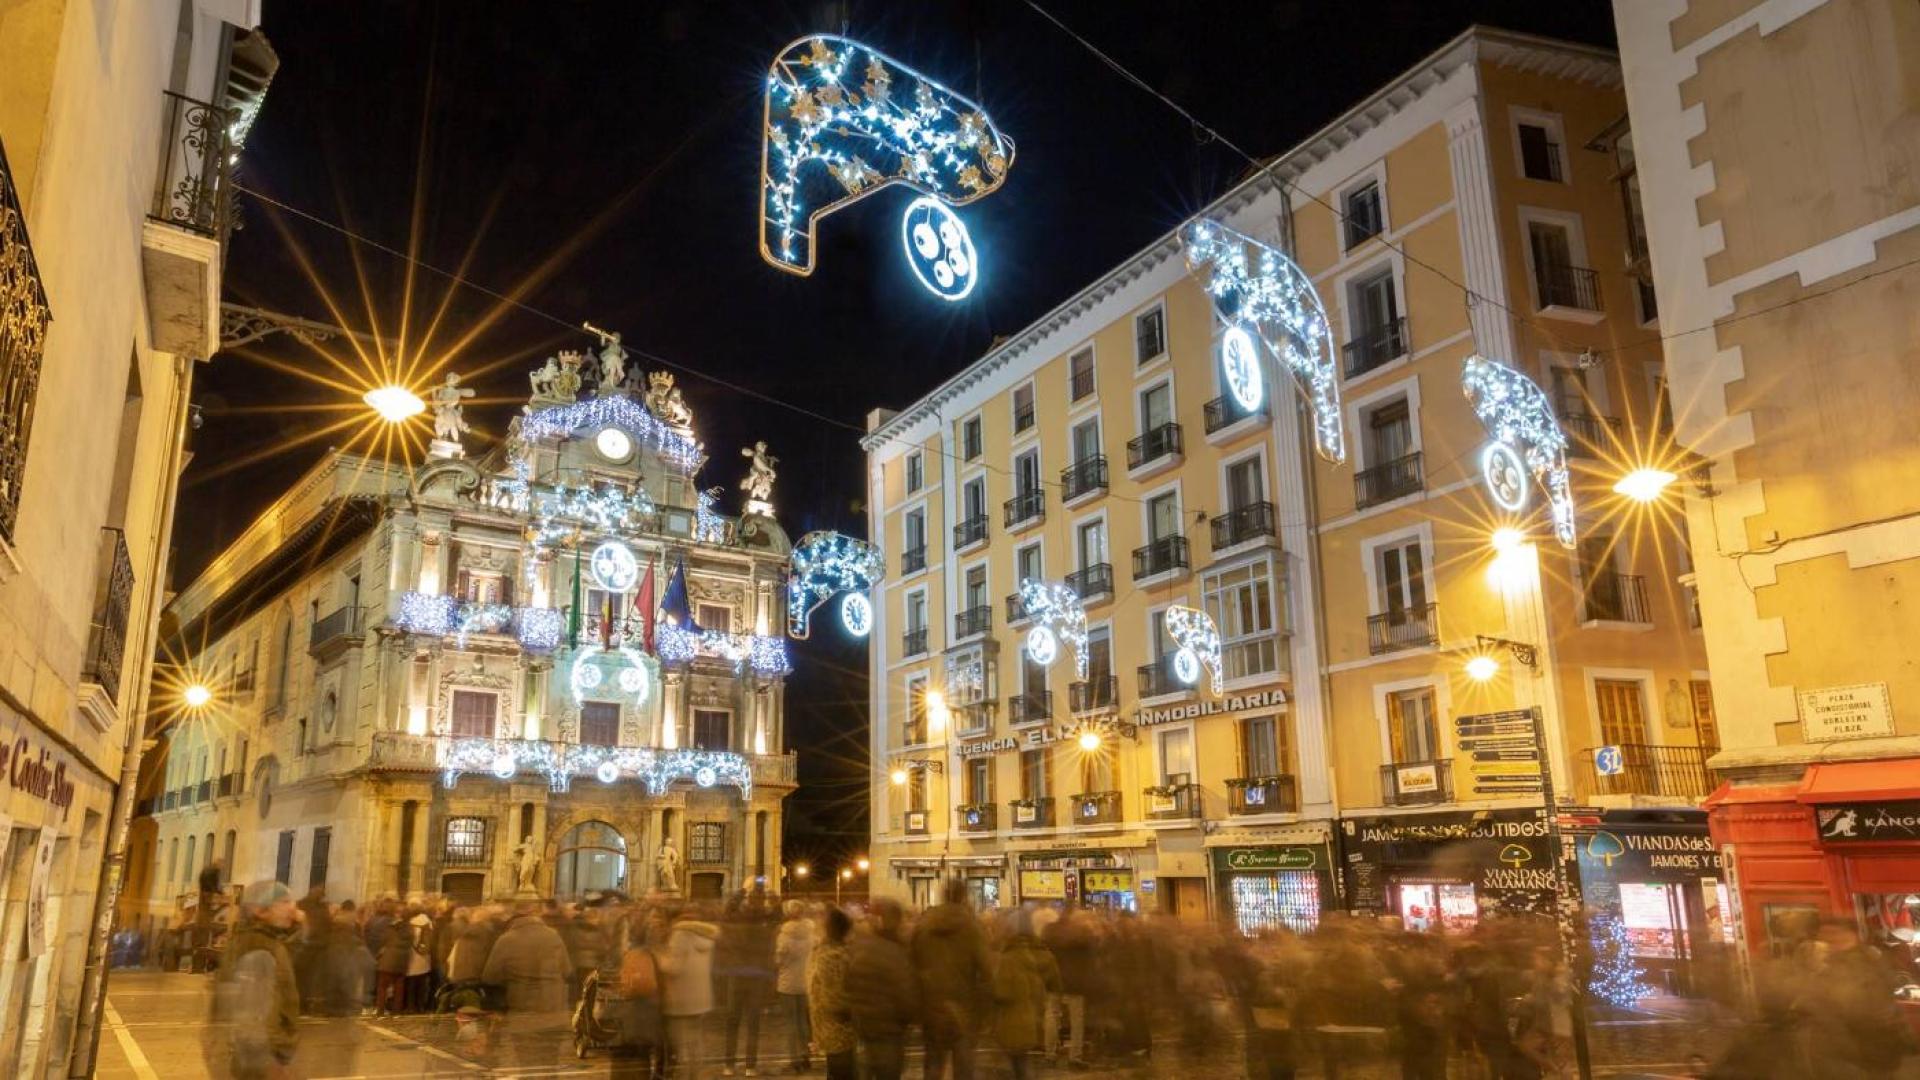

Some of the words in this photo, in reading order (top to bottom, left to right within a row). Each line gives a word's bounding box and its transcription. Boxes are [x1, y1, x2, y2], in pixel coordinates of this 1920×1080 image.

[1134, 689, 1286, 727] INMOBILIARIA
[1625, 834, 1689, 850] VIANDAS
[1690, 836, 1704, 851] de
[1650, 854, 1699, 868] JAMONES
[1701, 855, 1710, 868] Y
[1485, 868, 1545, 880] VIANDAS
